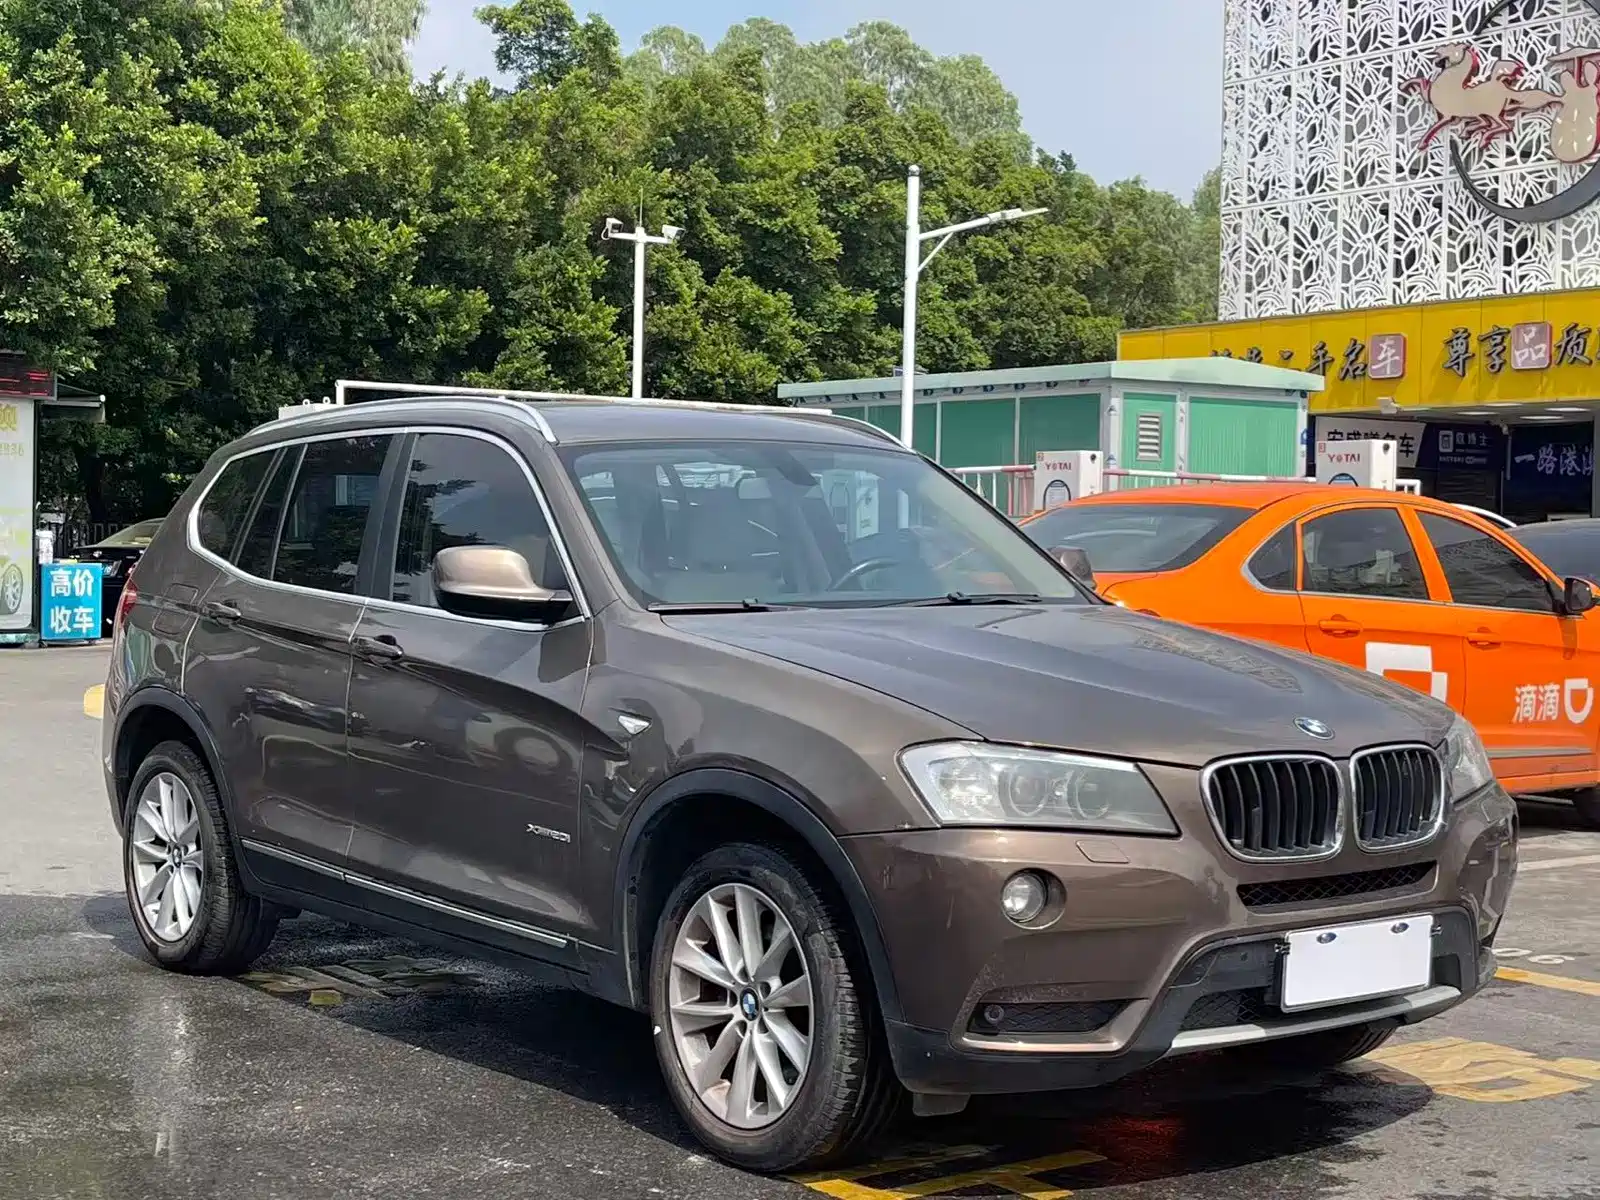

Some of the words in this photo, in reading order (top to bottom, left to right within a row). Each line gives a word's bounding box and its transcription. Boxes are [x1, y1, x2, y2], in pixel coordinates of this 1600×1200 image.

[1442, 322, 1600, 377] 尊享品质
[49, 567, 95, 599] 高价
[49, 605, 95, 635] 收车
[1512, 683, 1561, 723] 滴滴
